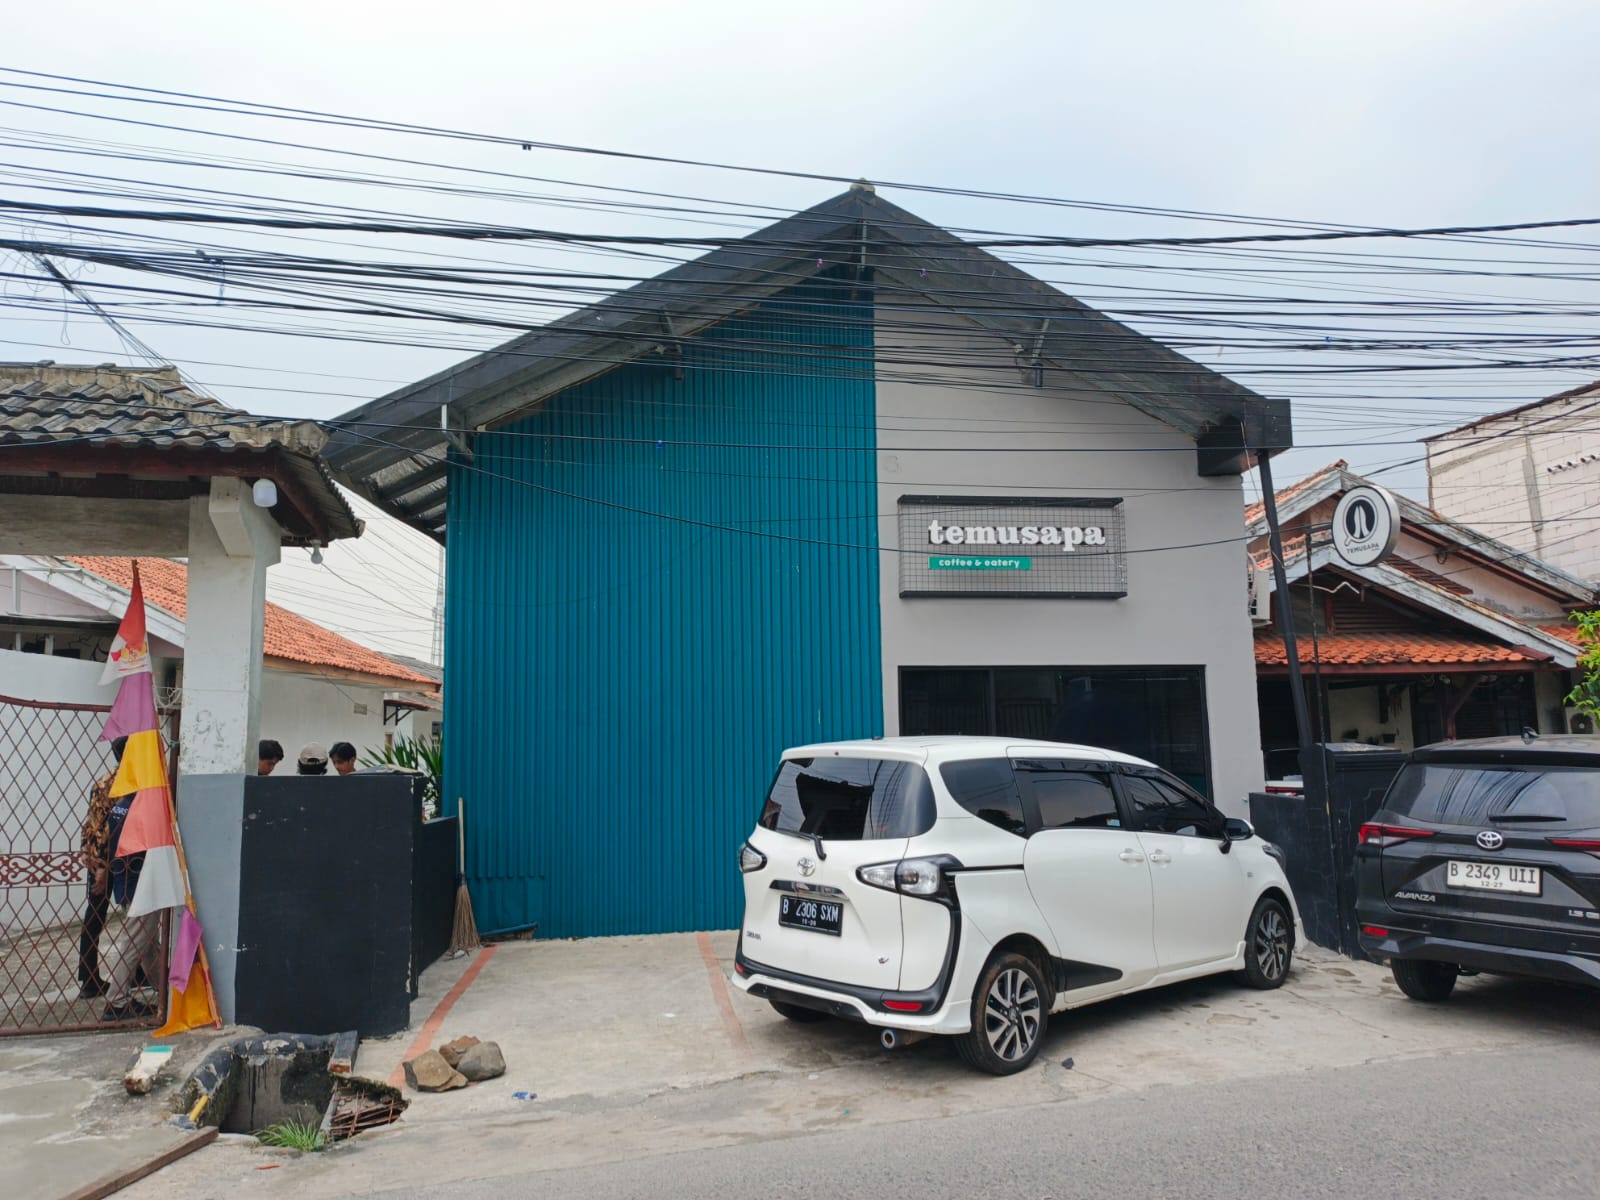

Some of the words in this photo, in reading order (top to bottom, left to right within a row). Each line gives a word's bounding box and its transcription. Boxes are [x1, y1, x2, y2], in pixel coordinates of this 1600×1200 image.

[928, 520, 1106, 551] temusapa
[938, 558, 974, 567] coffee
[974, 559, 982, 567] &
[984, 558, 1020, 568] eatery
[1450, 863, 1458, 876] B
[1465, 864, 1500, 881] 2349
[1509, 867, 1536, 884] UII
[1394, 891, 1436, 902] AVANZA
[783, 898, 789, 915] B
[820, 904, 839, 923] SXM
